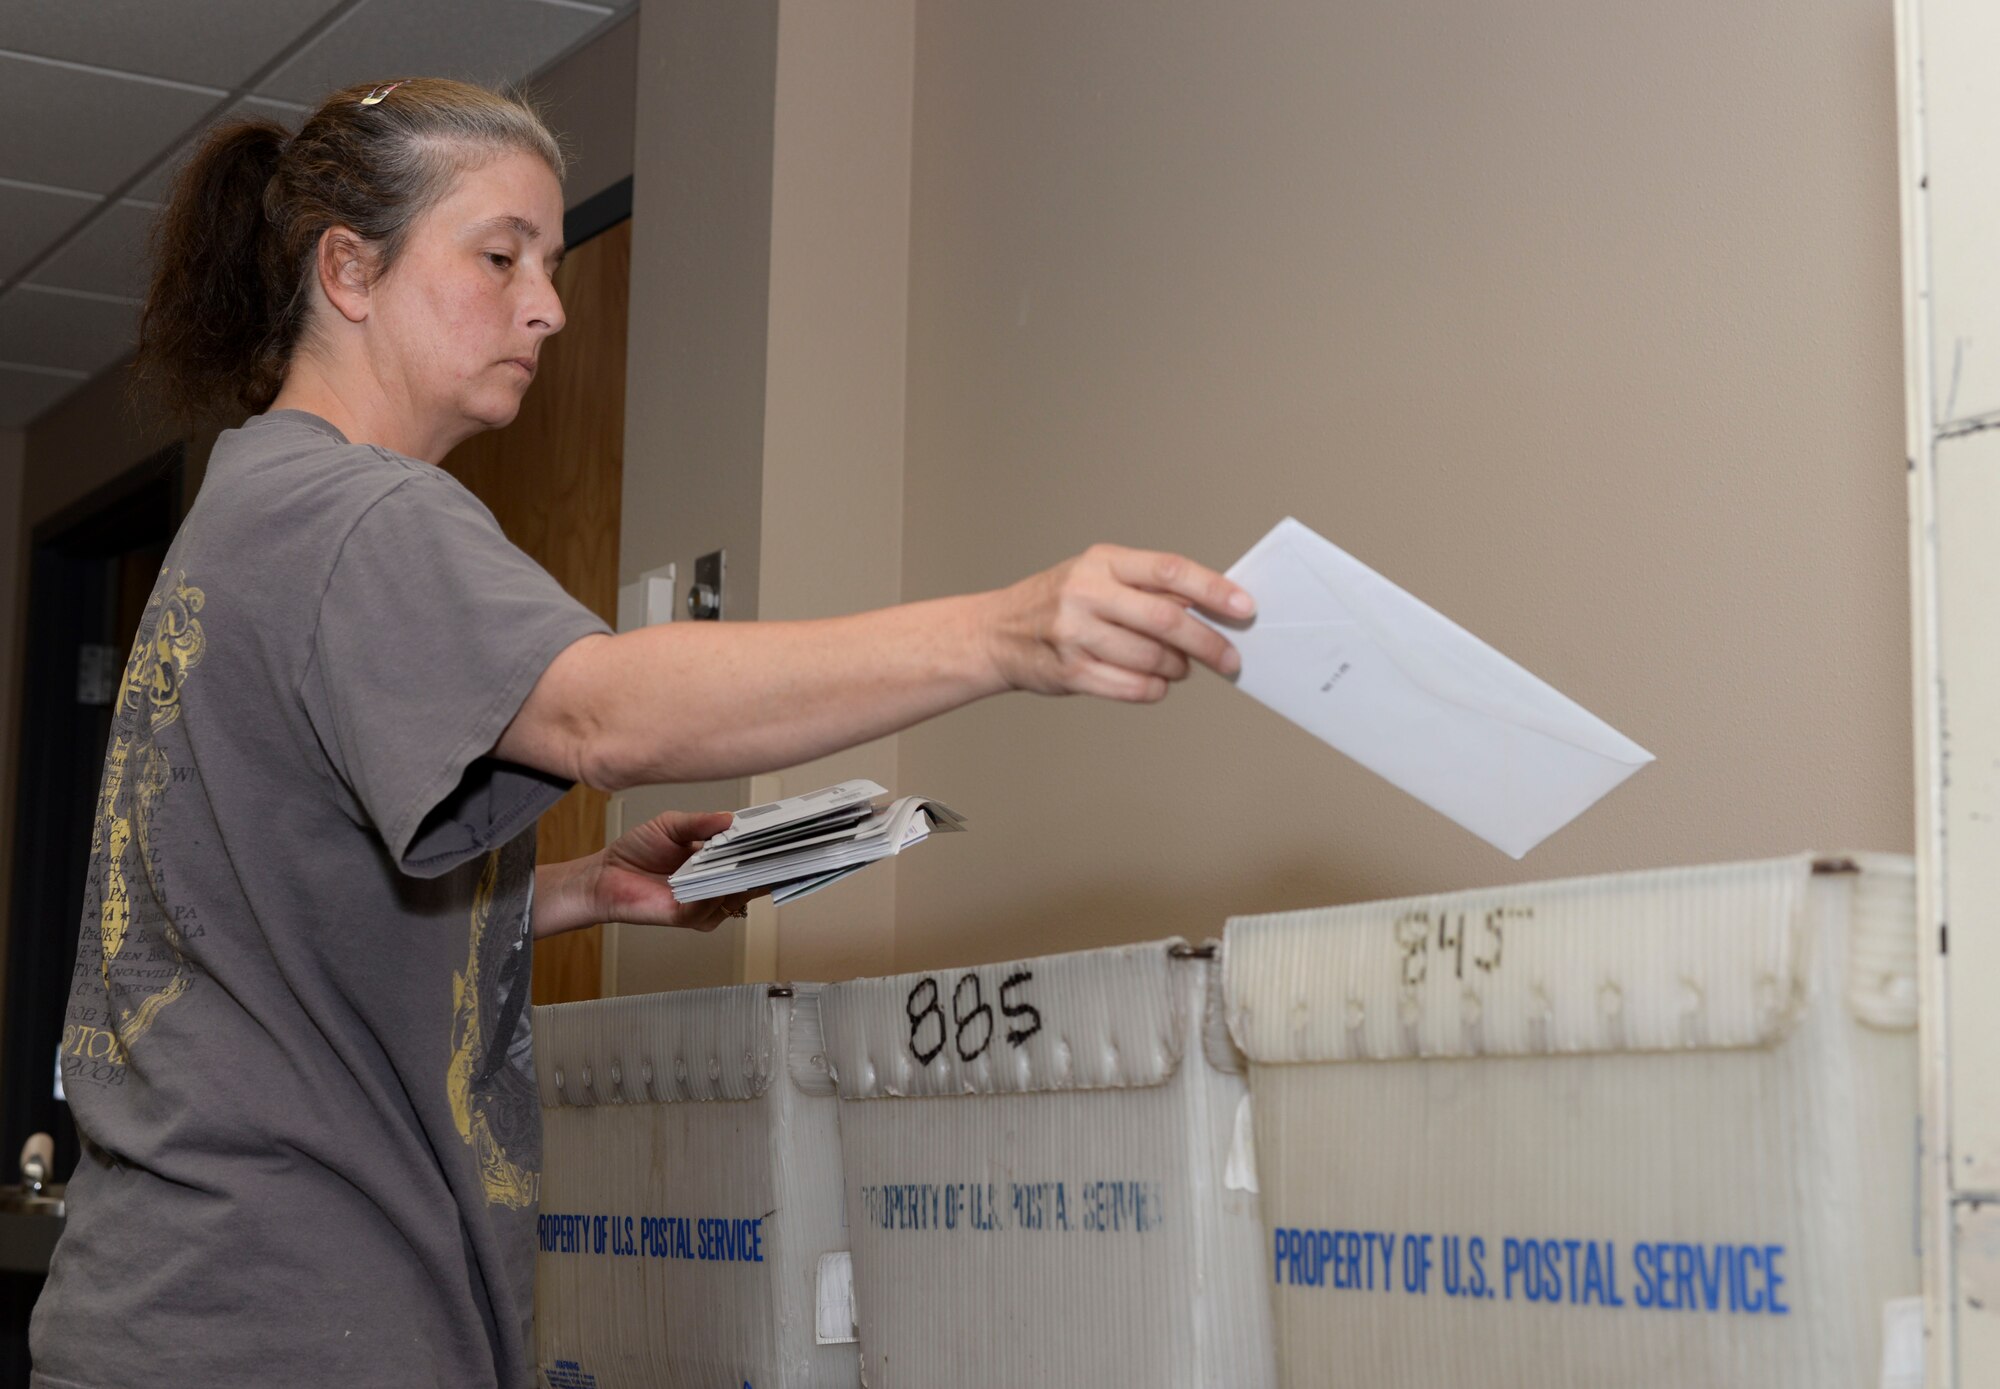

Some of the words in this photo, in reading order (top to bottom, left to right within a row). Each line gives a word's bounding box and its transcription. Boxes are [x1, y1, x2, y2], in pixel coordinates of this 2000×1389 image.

[907, 972, 1041, 1066] 885
[65, 1057, 127, 1085] 2008
[594, 1215, 608, 1254] OF
[612, 1215, 637, 1256] U.S.
[641, 1217, 695, 1259] POSTAL
[697, 1218, 763, 1261] SERVICE
[1274, 1227, 1396, 1291] PROPERTY
[1403, 1234, 1434, 1294] OF
[1442, 1235, 1495, 1299] U.S.
[1503, 1238, 1624, 1306] POSTAL
[1633, 1243, 1790, 1314] SERVICE
